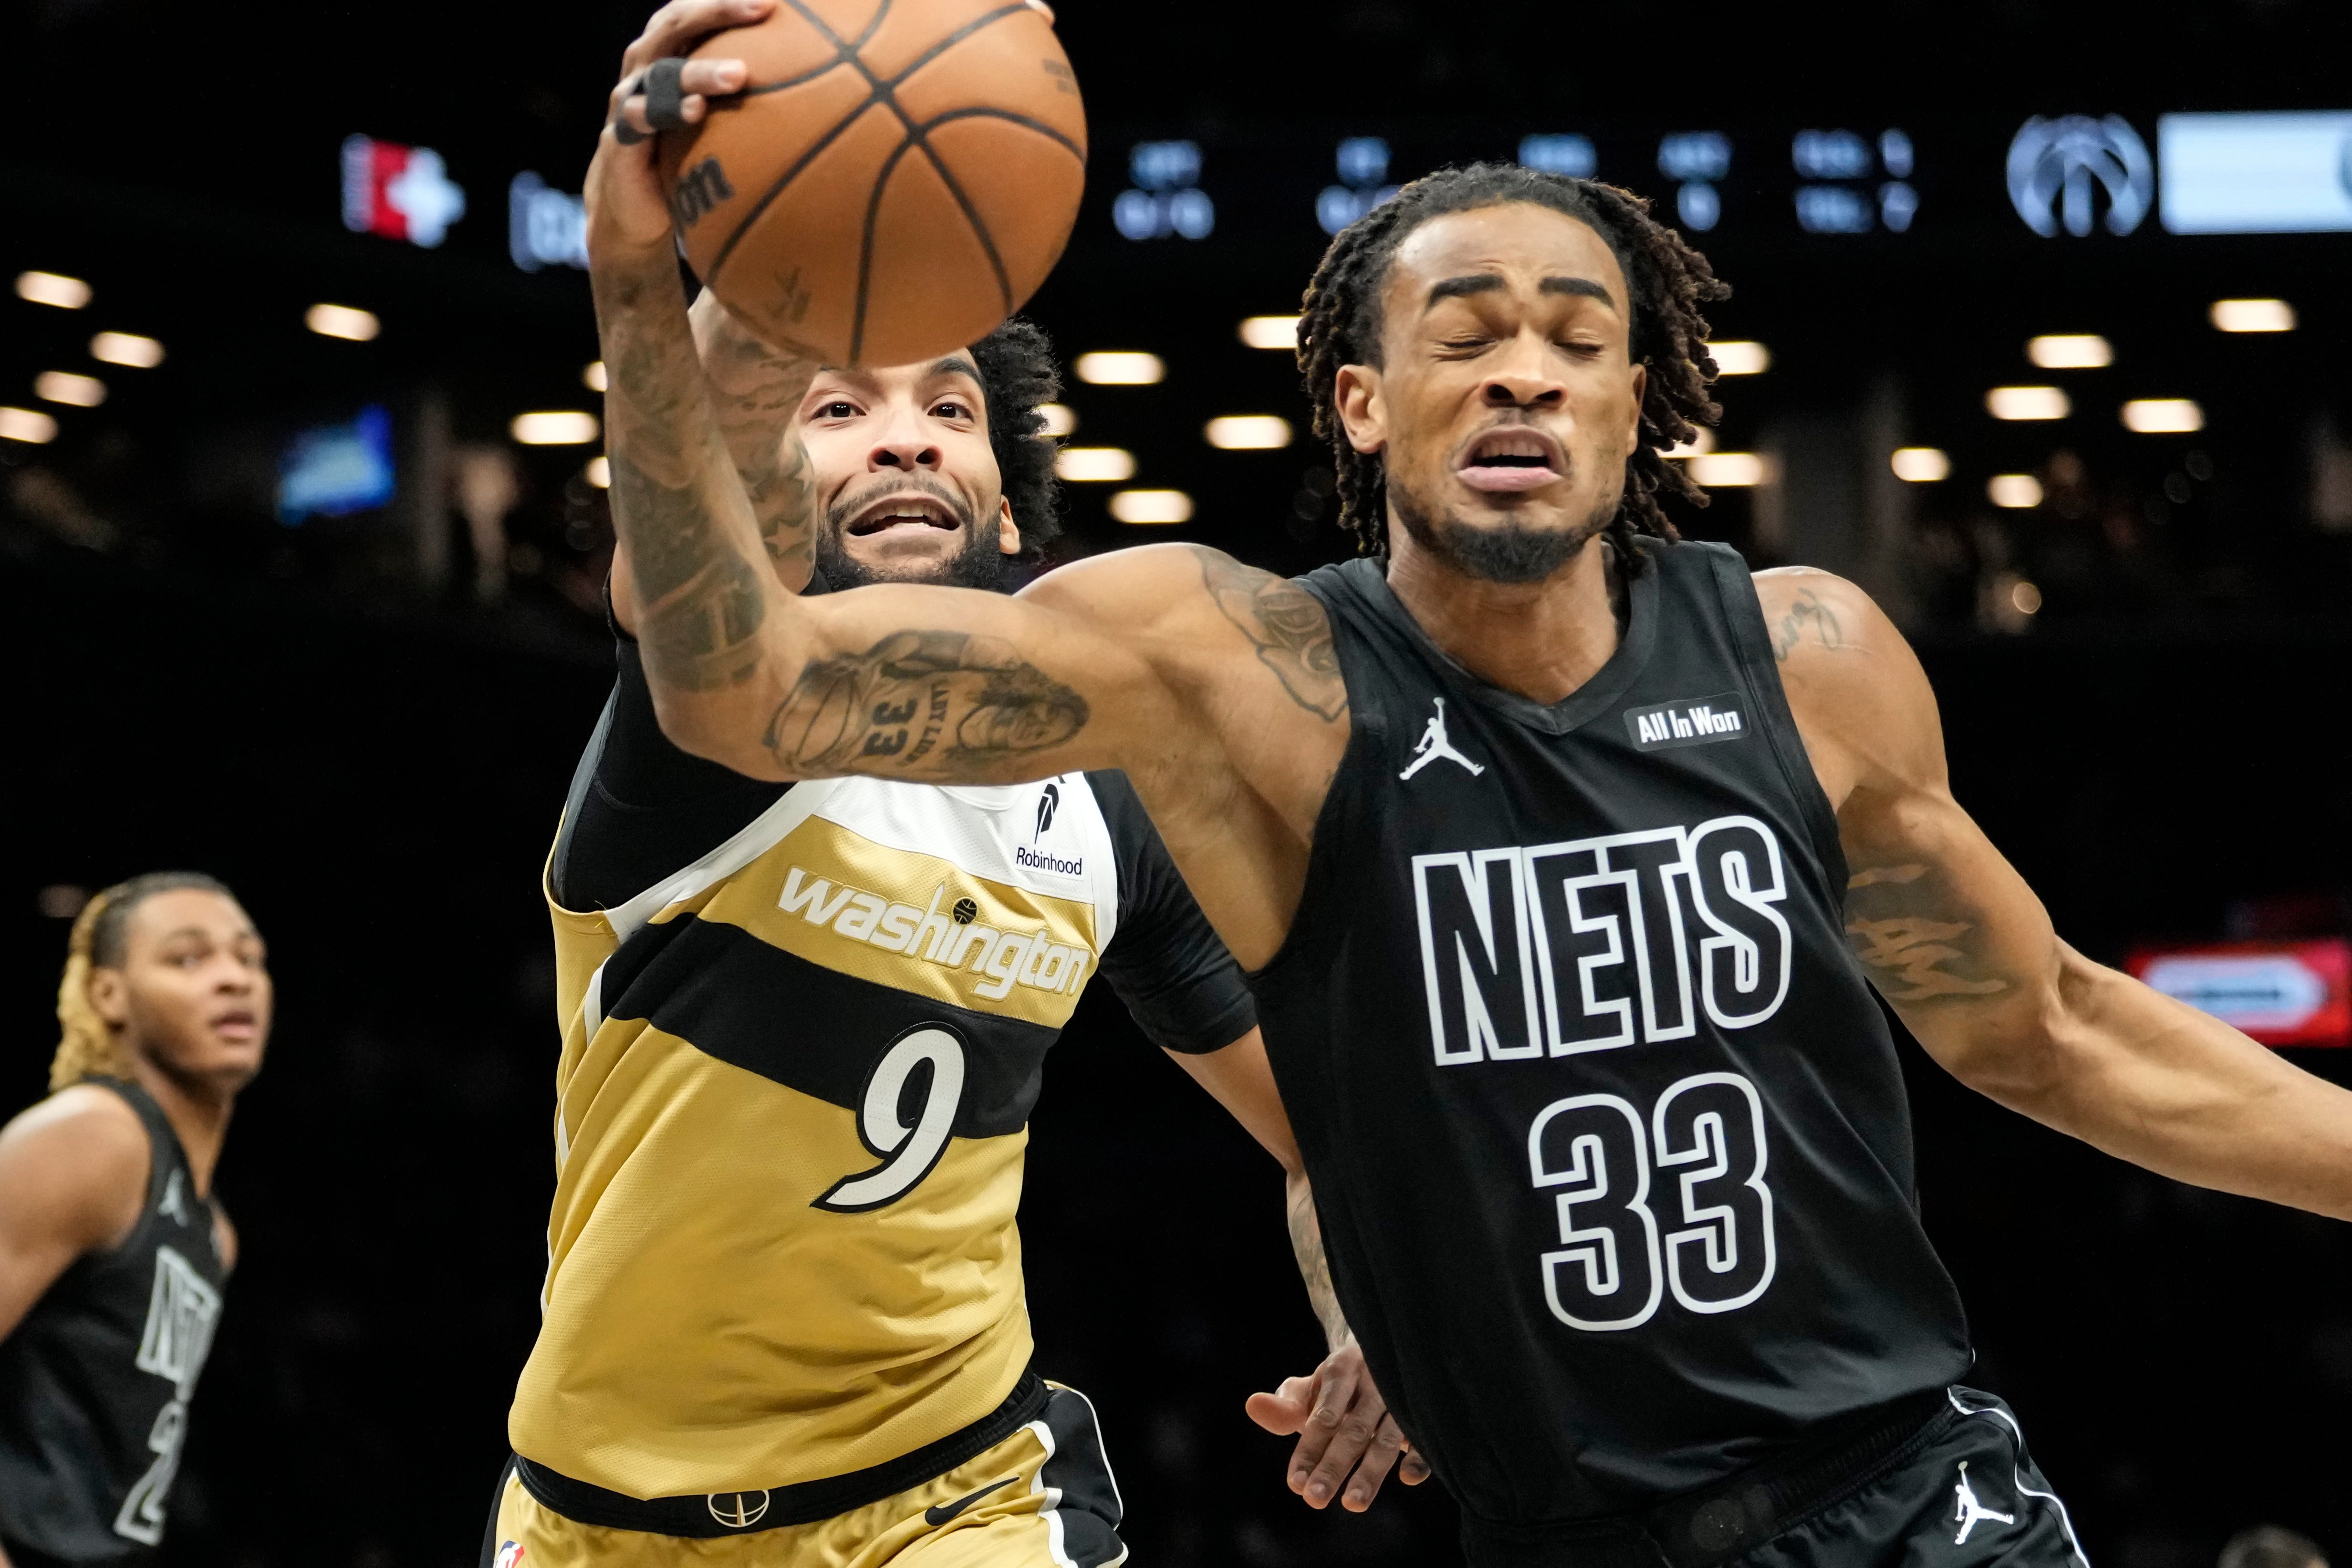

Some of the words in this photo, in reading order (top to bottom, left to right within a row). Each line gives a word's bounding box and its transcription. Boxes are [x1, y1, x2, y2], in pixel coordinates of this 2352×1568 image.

[861, 696, 917, 755] 33
[1637, 712, 1670, 743] All
[1668, 709, 1694, 738] In
[1688, 706, 1741, 736] Won
[1016, 847, 1082, 876] Robinhood
[776, 865, 1092, 1002] washington
[1411, 815, 1792, 1066] NETS
[810, 1024, 969, 1213] 9
[1528, 1072, 1776, 1331] 33
